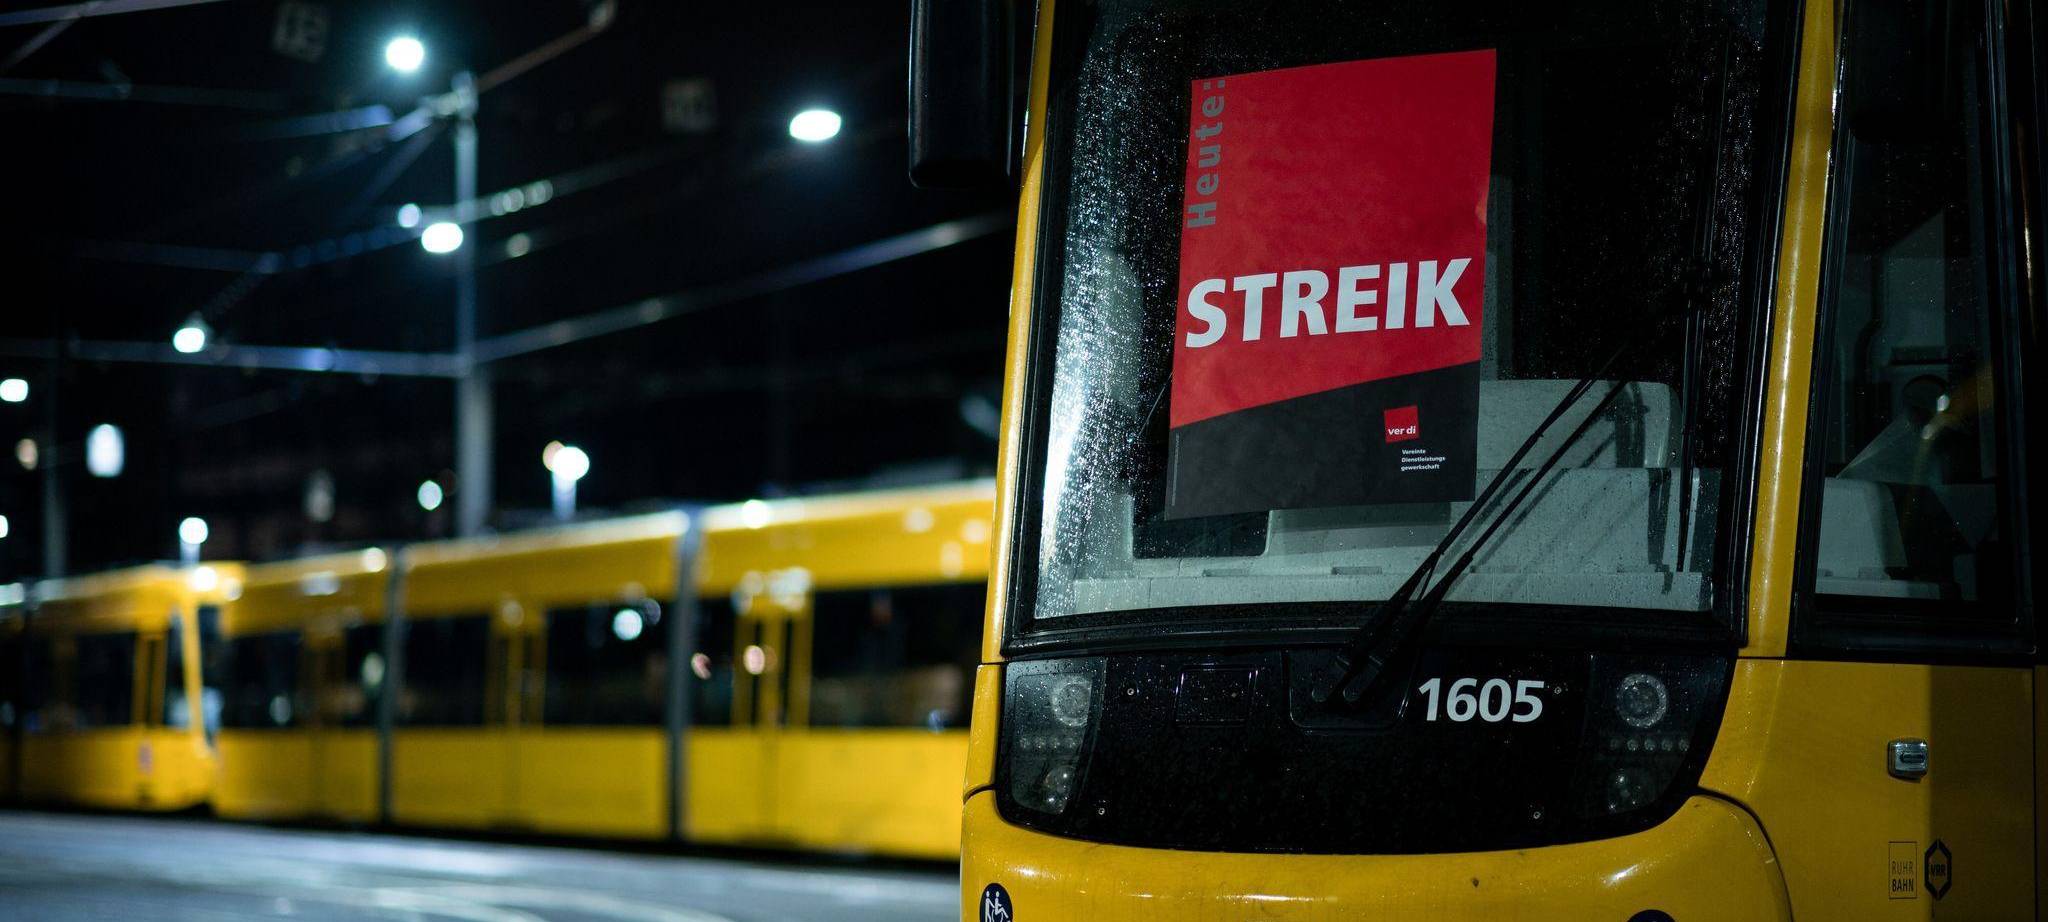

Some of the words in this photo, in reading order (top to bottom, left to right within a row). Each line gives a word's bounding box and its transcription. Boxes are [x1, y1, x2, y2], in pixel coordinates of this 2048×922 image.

[1186, 79, 1226, 228] Heute:
[1185, 257, 1472, 348] STREIK
[1418, 677, 1545, 722] 1605
[1891, 860, 1914, 875] RUHR
[1892, 879, 1914, 892] BAHN
